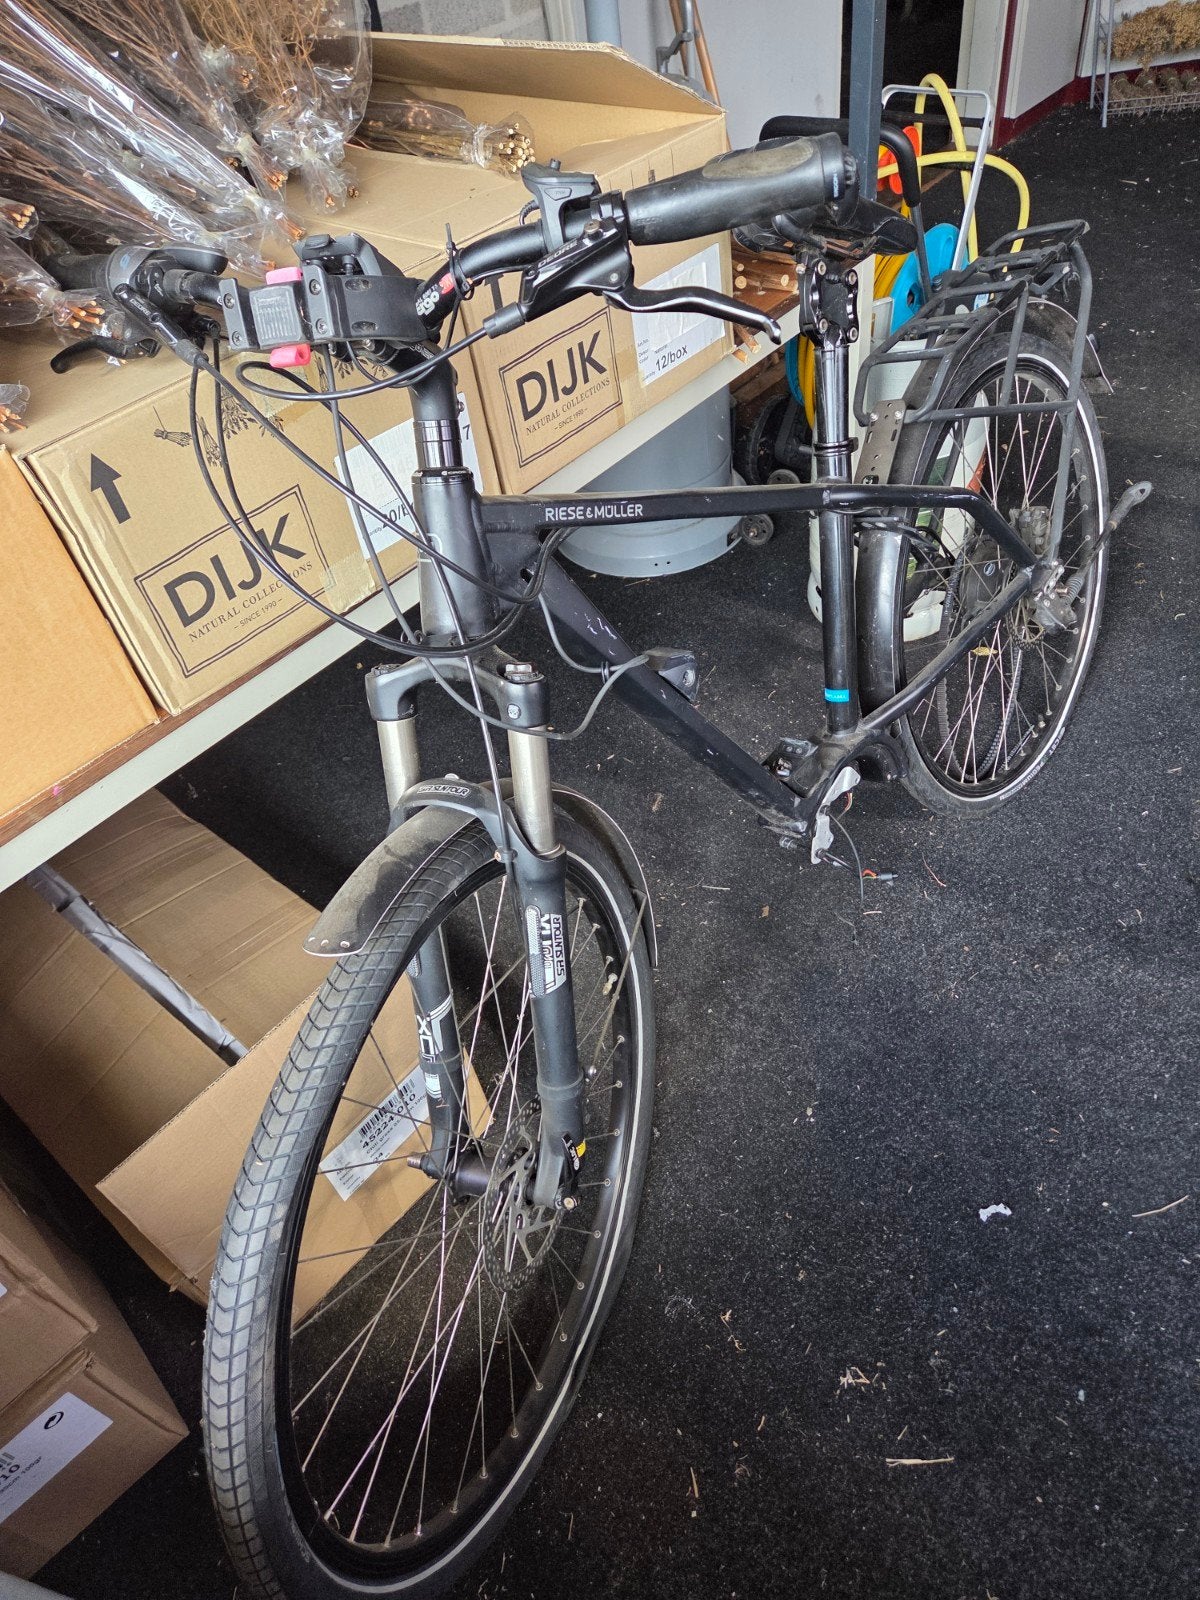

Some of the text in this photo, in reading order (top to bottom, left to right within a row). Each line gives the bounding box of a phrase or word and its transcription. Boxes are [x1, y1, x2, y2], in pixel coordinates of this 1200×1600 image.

[516, 330, 607, 422] DIJK
[655, 345, 688, 371] 12/box
[526, 377, 611, 435] NATURAL COLLECTIONS
[558, 407, 585, 429] SINCE 1990
[164, 512, 306, 628] DIJK
[188, 561, 313, 642] NATURAL COLLECONS
[239, 601, 277, 627] SINCE 1990
[553, 917, 565, 976] SR SUNTOUR
